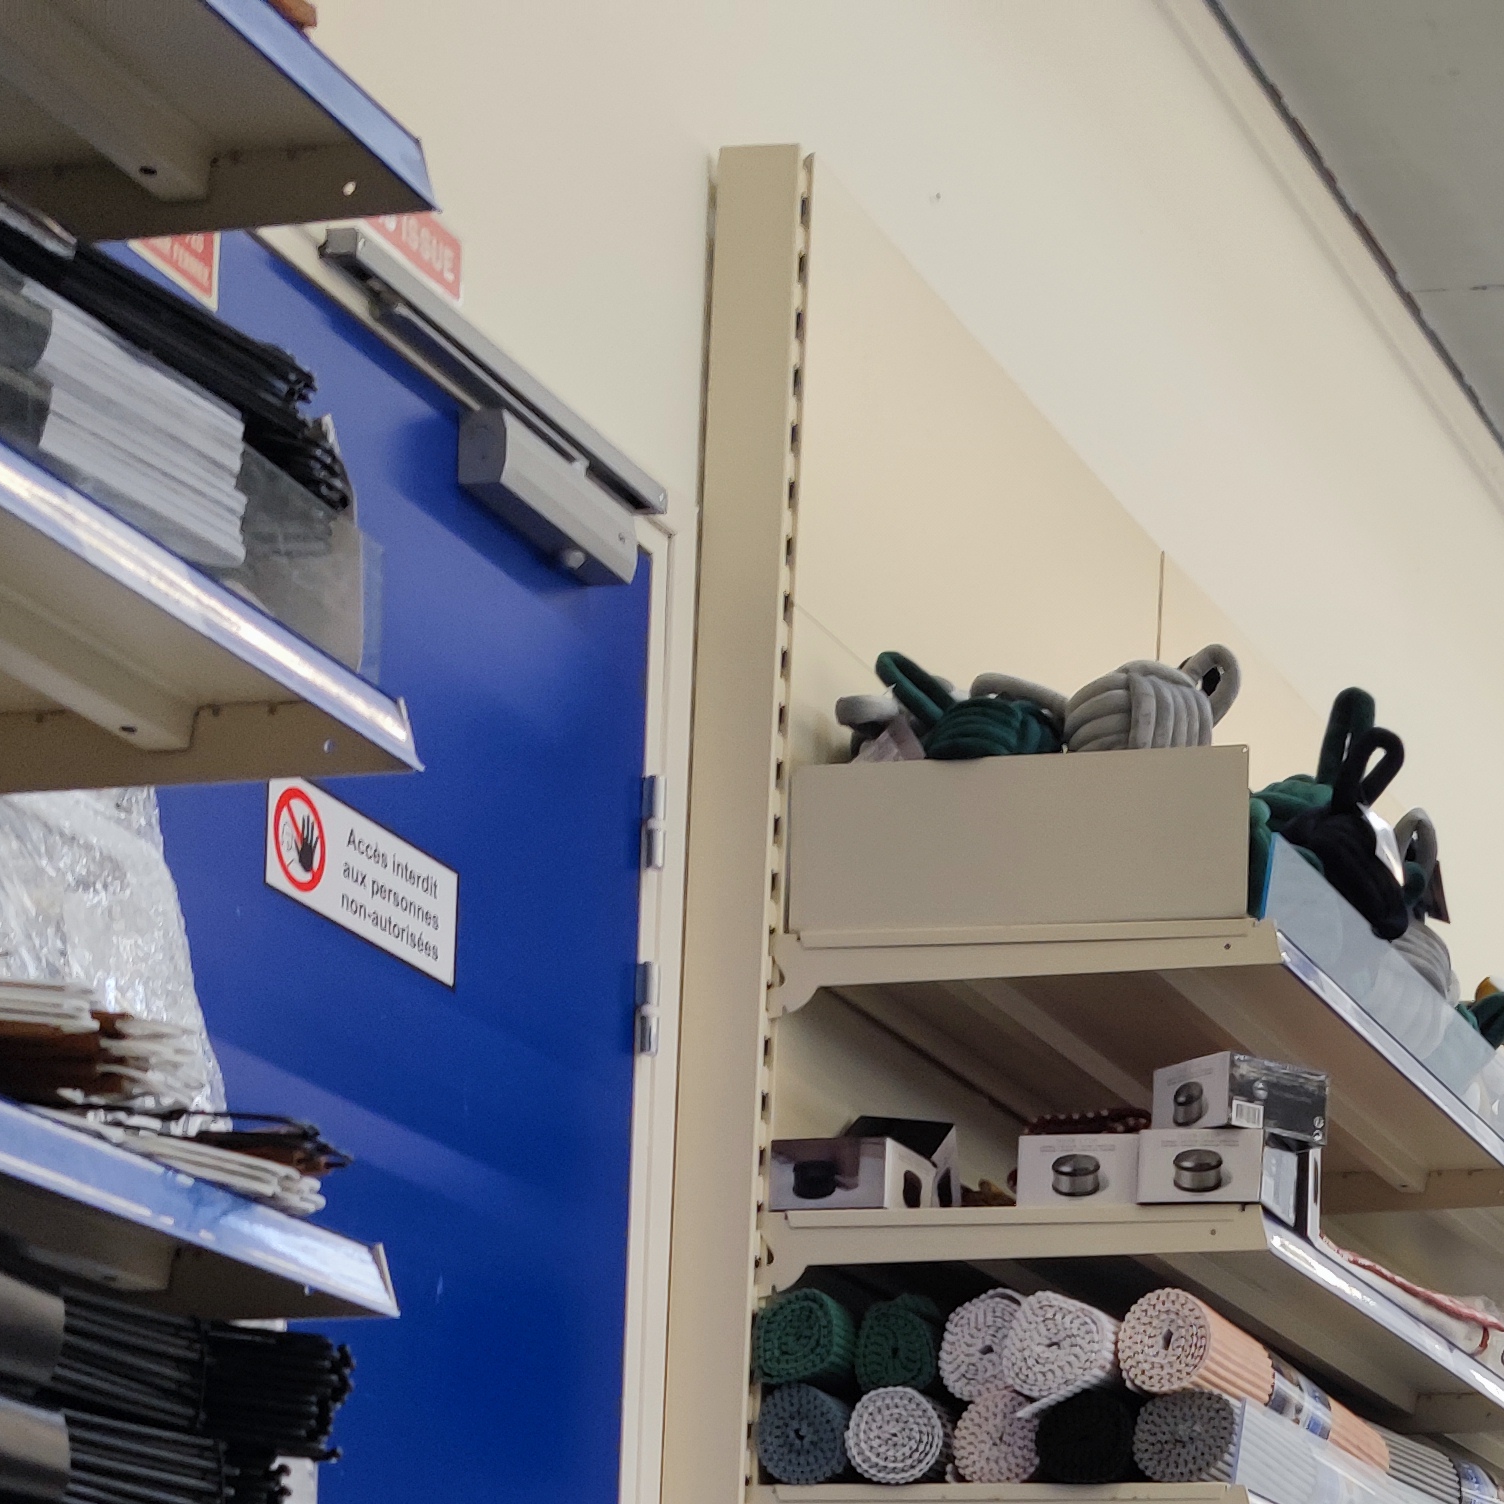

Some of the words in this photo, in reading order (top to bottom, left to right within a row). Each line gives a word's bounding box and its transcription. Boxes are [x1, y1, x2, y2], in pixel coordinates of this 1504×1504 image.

[342, 860, 368, 890] aux
[371, 878, 440, 931] personnes
[346, 827, 388, 869] Accès
[392, 852, 438, 900] interdit
[341, 891, 439, 962] non-autorisées
